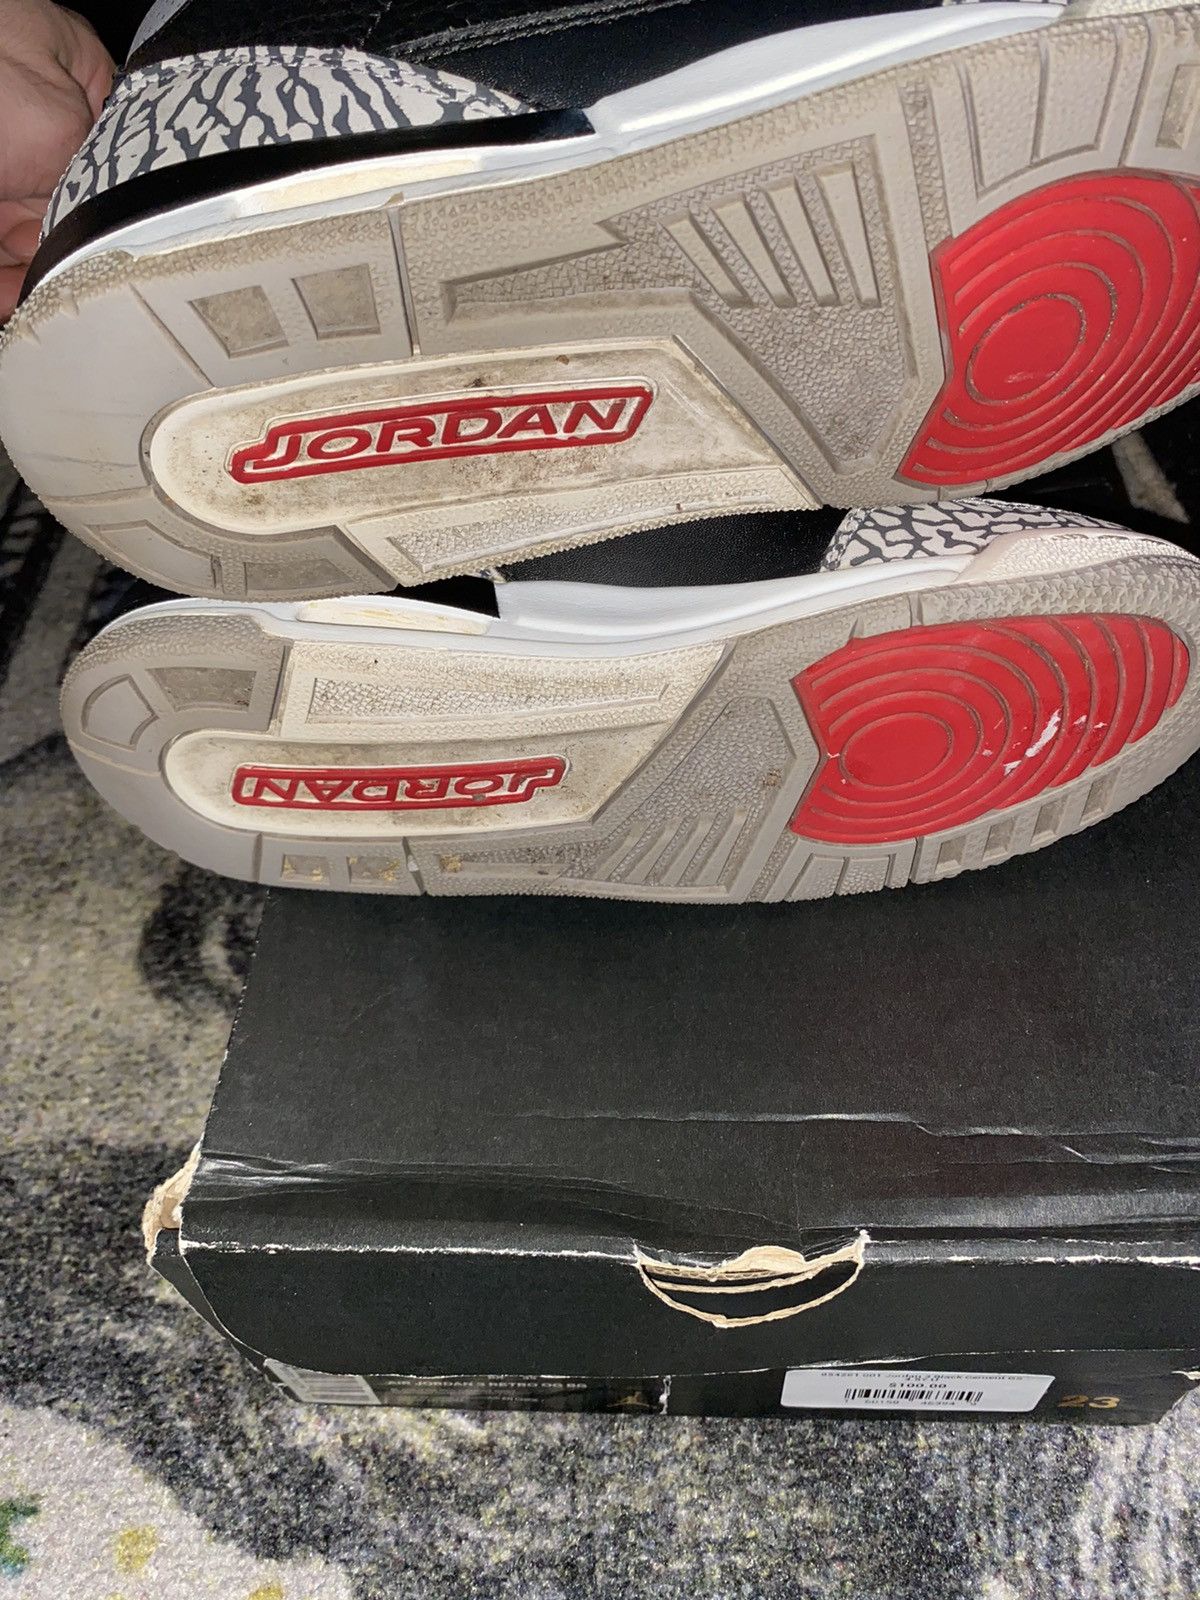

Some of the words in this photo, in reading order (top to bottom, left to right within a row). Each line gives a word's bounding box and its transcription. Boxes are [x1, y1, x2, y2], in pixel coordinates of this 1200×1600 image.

[252, 401, 628, 469] JORDAN
[253, 768, 549, 803] JORDAN
[1058, 1395, 1120, 1409] 23
